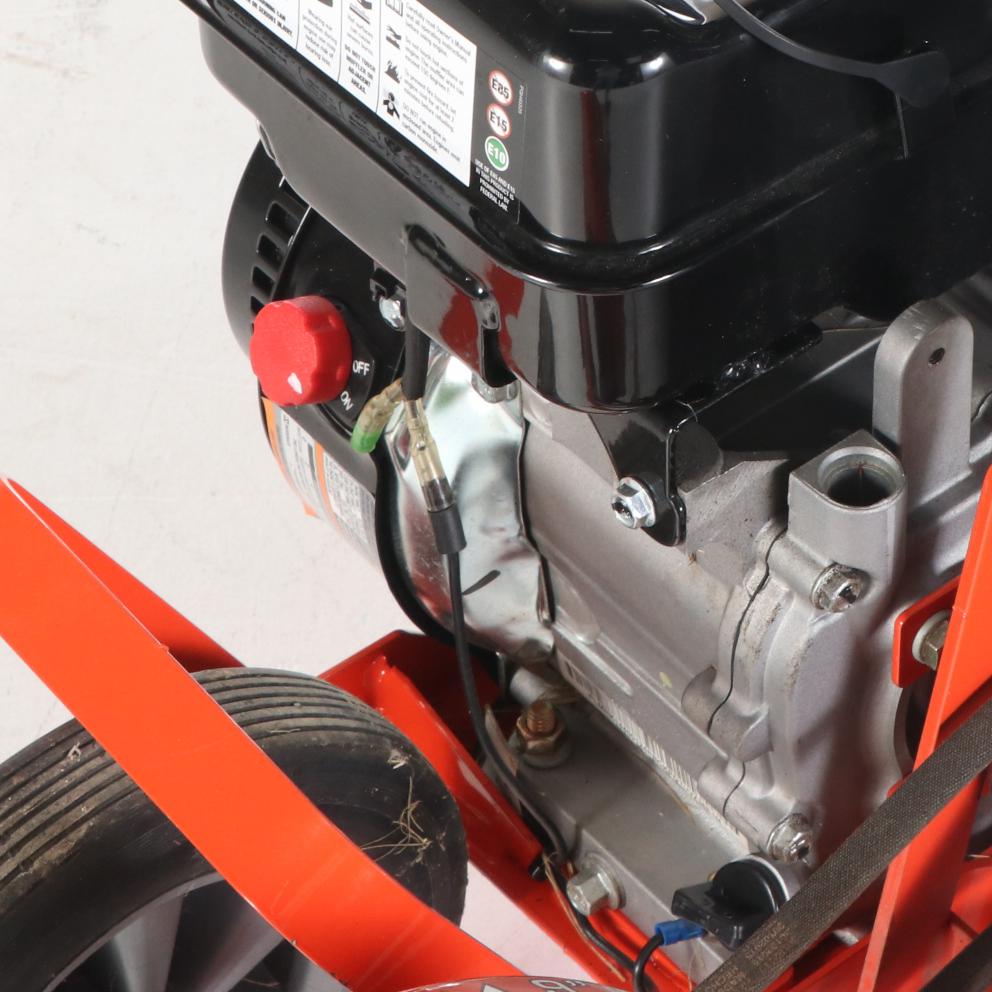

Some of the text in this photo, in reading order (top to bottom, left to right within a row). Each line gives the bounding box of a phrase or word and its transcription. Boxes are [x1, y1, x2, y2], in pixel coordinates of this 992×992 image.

[491, 78, 510, 100] E85
[489, 111, 509, 133] E15
[487, 142, 506, 165] E10
[352, 360, 370, 377] OFF
[340, 390, 354, 411] ON
